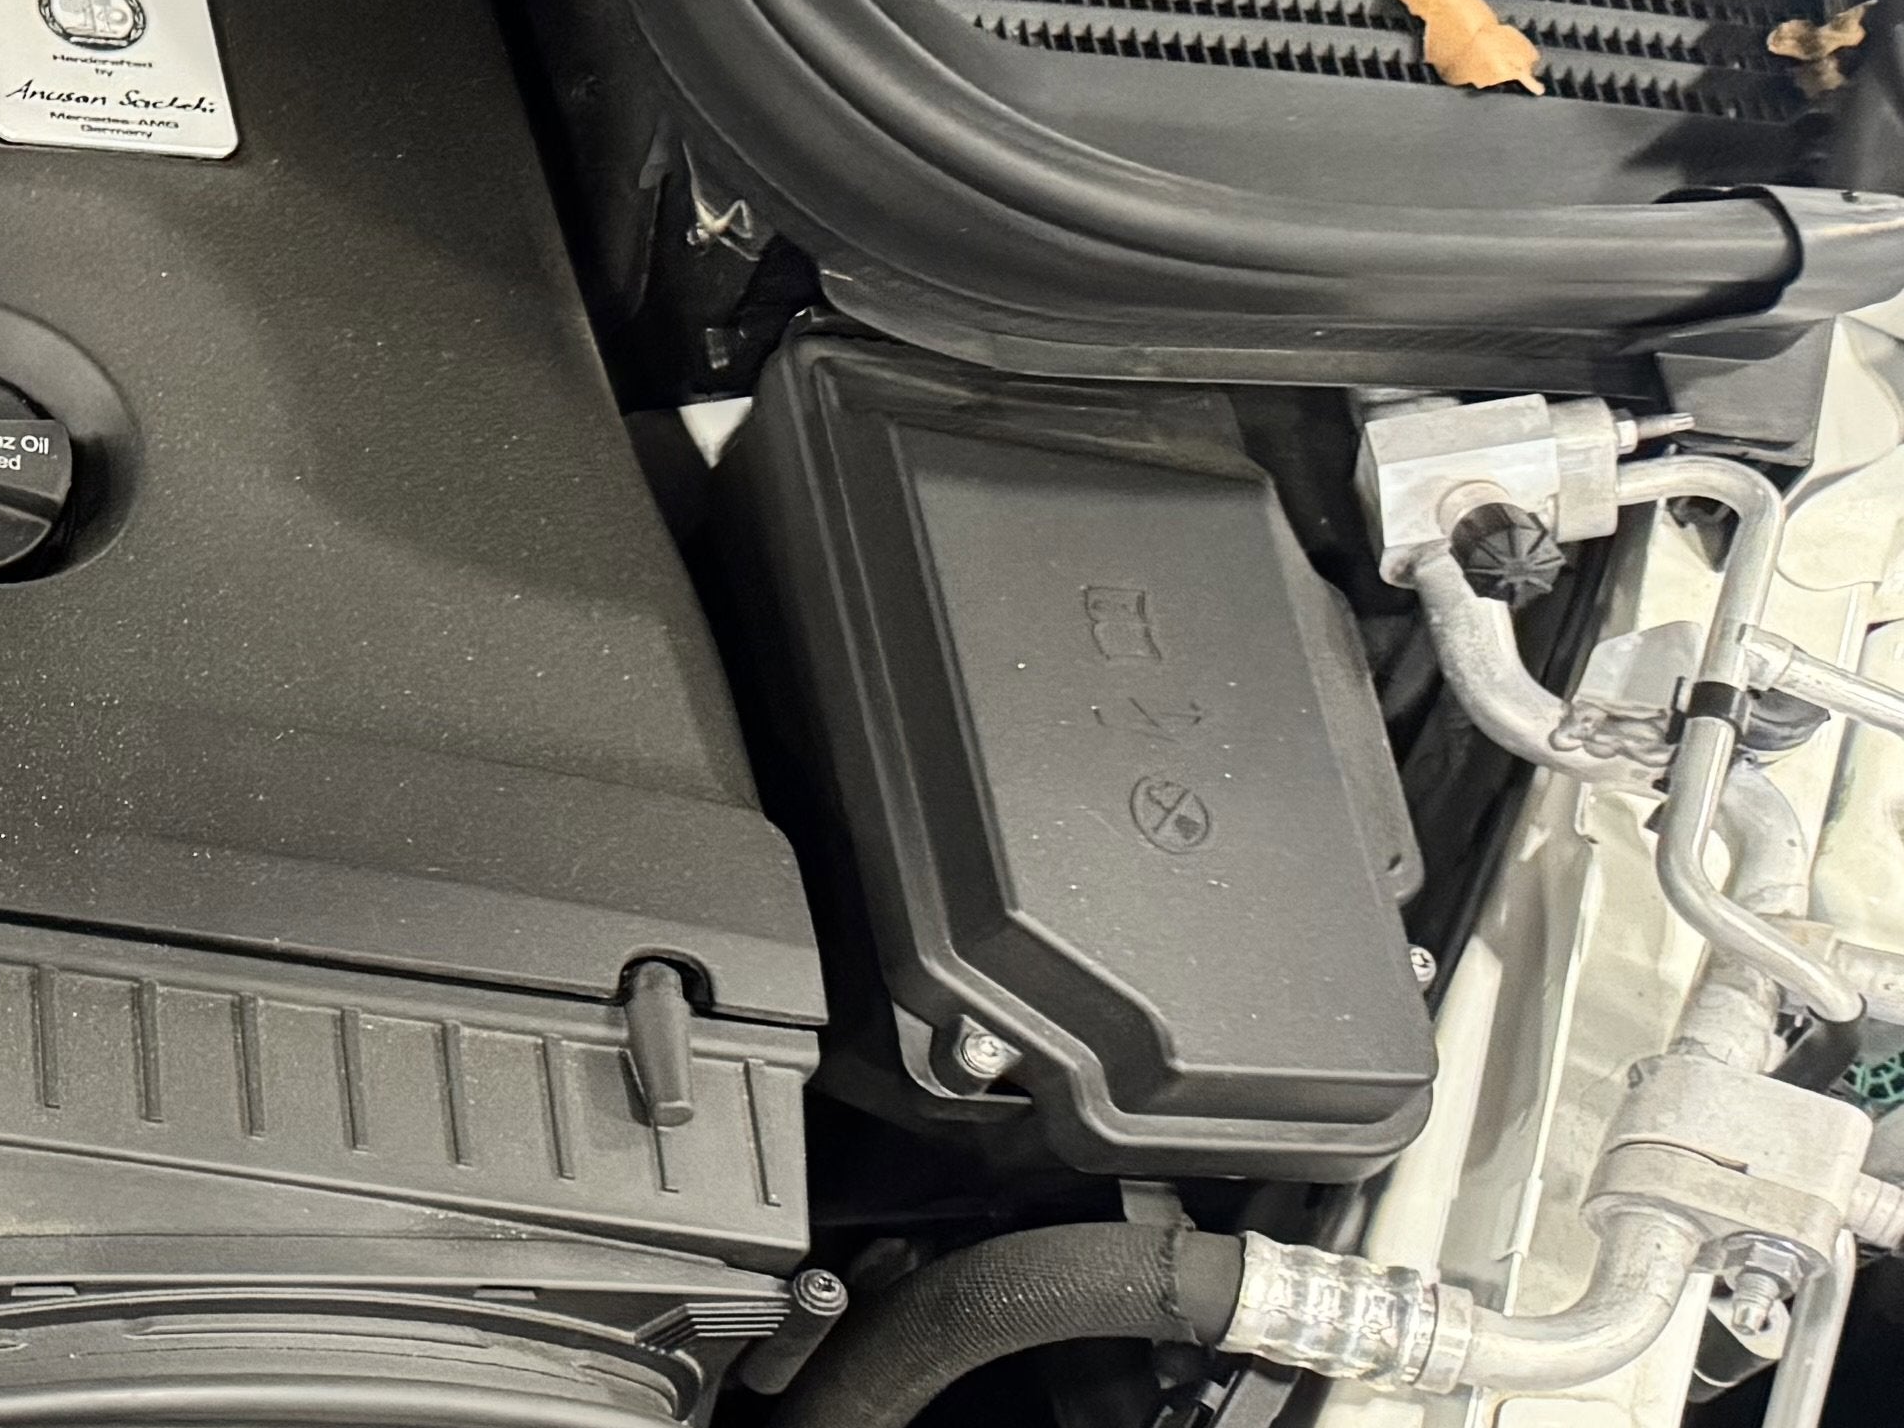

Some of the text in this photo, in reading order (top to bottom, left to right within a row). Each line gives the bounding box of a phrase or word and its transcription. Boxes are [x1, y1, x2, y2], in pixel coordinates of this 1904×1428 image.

[52, 54, 153, 68] Handcrafted
[94, 68, 114, 77] by
[80, 124, 153, 138] Germany
[21, 436, 49, 454] Oil
